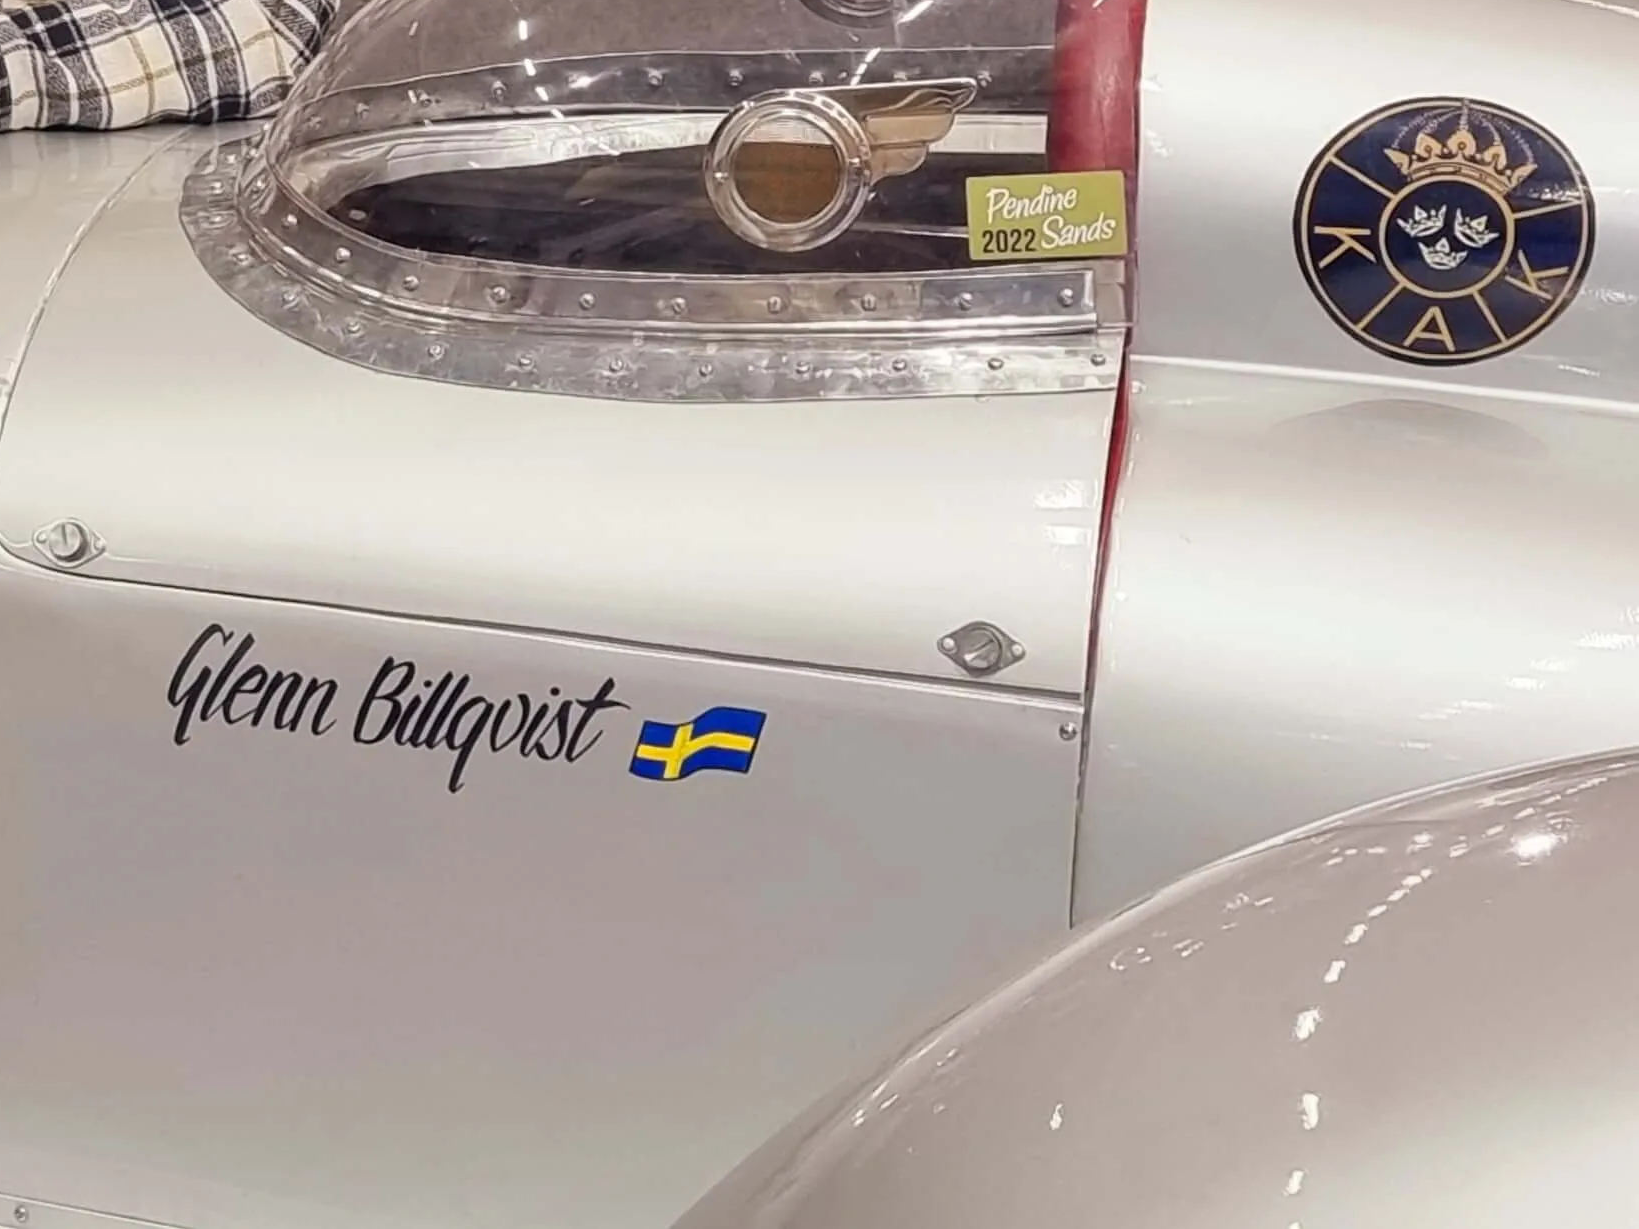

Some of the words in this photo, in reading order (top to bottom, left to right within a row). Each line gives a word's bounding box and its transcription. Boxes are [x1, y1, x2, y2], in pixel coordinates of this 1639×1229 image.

[985, 186, 1078, 226] Pendine
[981, 227, 1037, 254] 2022
[1040, 216, 1118, 251] Sands
[1402, 305, 1457, 352] A
[167, 623, 337, 746] Glenn
